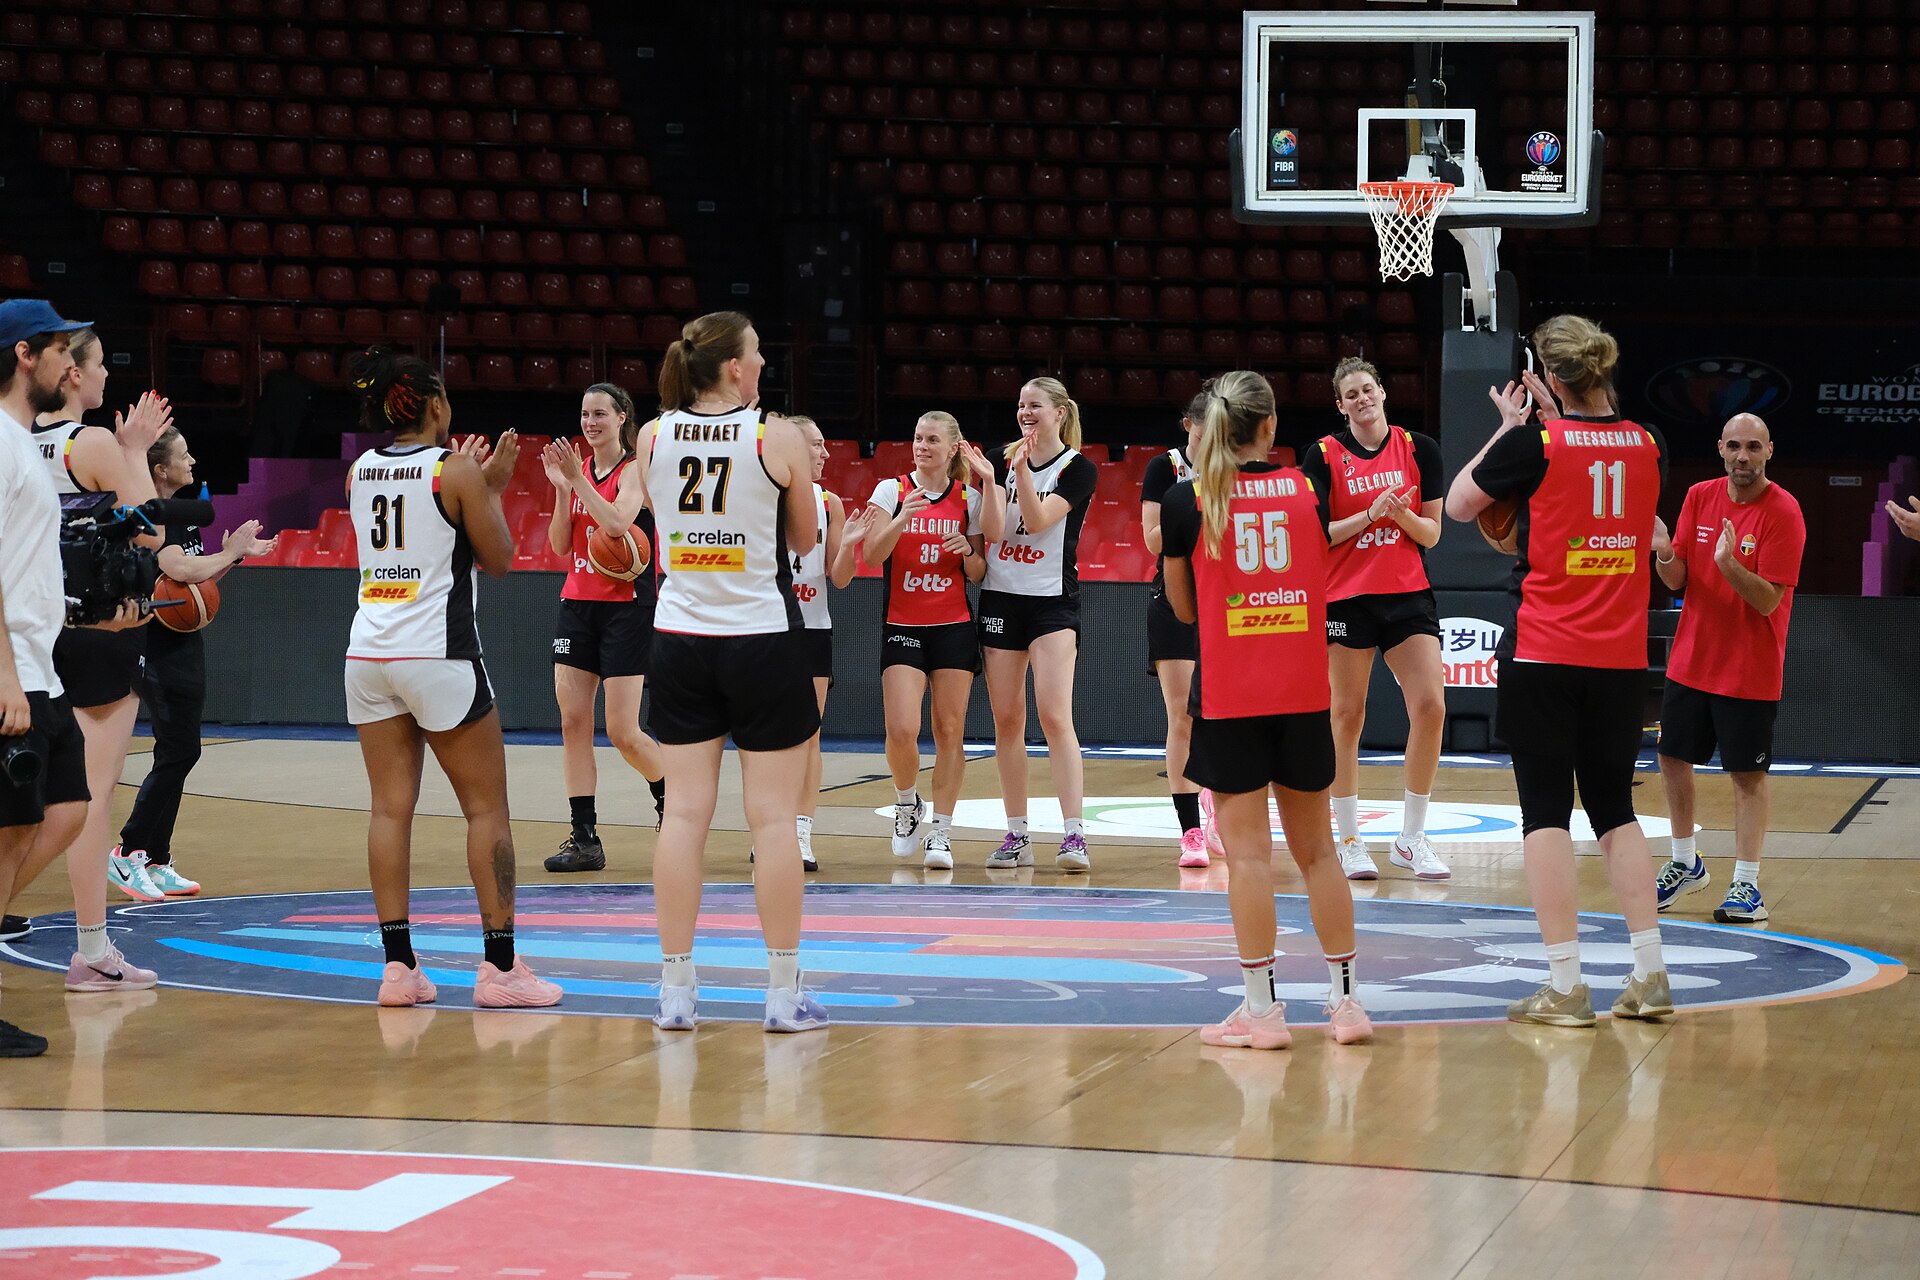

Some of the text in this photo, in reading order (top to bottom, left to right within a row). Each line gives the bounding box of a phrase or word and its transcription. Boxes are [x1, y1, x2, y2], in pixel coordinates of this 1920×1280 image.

[1274, 161, 1295, 172] FIBA
[1521, 173, 1564, 183] EUROBASKET
[1844, 415, 1913, 423] ITALY
[673, 422, 742, 443] VERVAET
[1564, 430, 1644, 447] MEESSEMAN
[358, 466, 423, 481] LISOWA-MBAKA
[678, 456, 733, 516] 27
[1347, 470, 1405, 497] BELGIUM
[1588, 460, 1627, 520] 11
[370, 494, 405, 552] 31
[687, 530, 746, 546] crelan
[1233, 510, 1292, 576] 55
[1589, 532, 1637, 549] crelan
[680, 553, 732, 566] DHL
[920, 543, 940, 565] 35
[1579, 556, 1625, 570] DHL
[374, 564, 422, 580] crelan
[368, 587, 410, 599] DHL
[1248, 587, 1308, 607] crelan
[1241, 613, 1296, 628] DHL
[1325, 620, 1347, 630] WER
[986, 624, 1004, 634] ADE
[1328, 628, 1348, 637] ADE
[1440, 628, 1498, 652] 岁山
[554, 646, 571, 654] ADE
